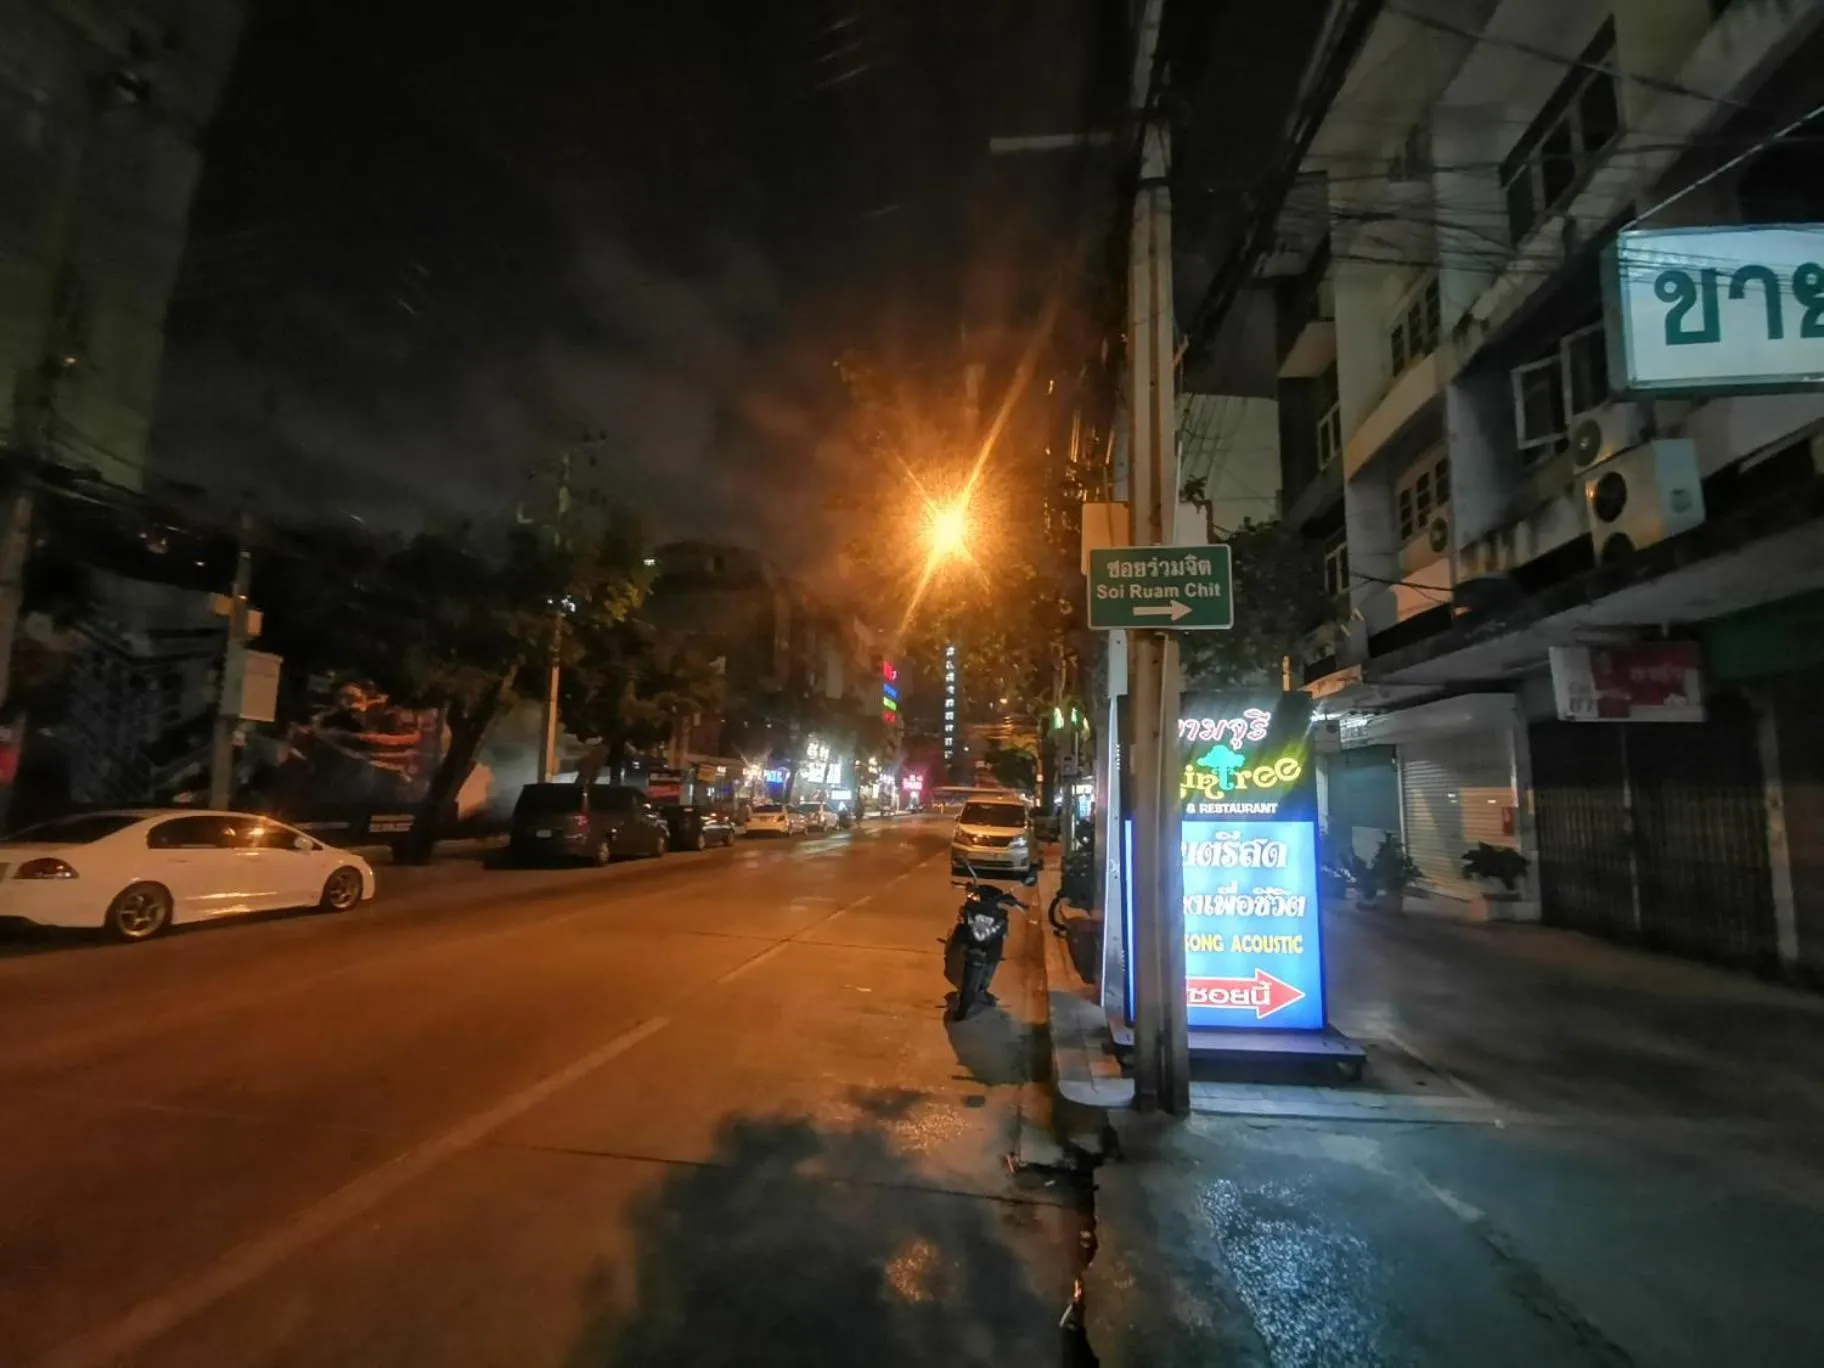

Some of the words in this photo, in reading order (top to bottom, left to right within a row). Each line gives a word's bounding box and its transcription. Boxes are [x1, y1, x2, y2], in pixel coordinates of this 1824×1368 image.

[1107, 554, 1212, 578] ซอยร่วมจิต
[1096, 584, 1124, 599] Soi
[1129, 584, 1180, 599] Ruam
[1184, 582, 1222, 598] Chit
[1178, 708, 1271, 751] ามจุรี
[1199, 802, 1278, 815] RESTAURANT
[1231, 934, 1304, 955] ACOUSTIC
